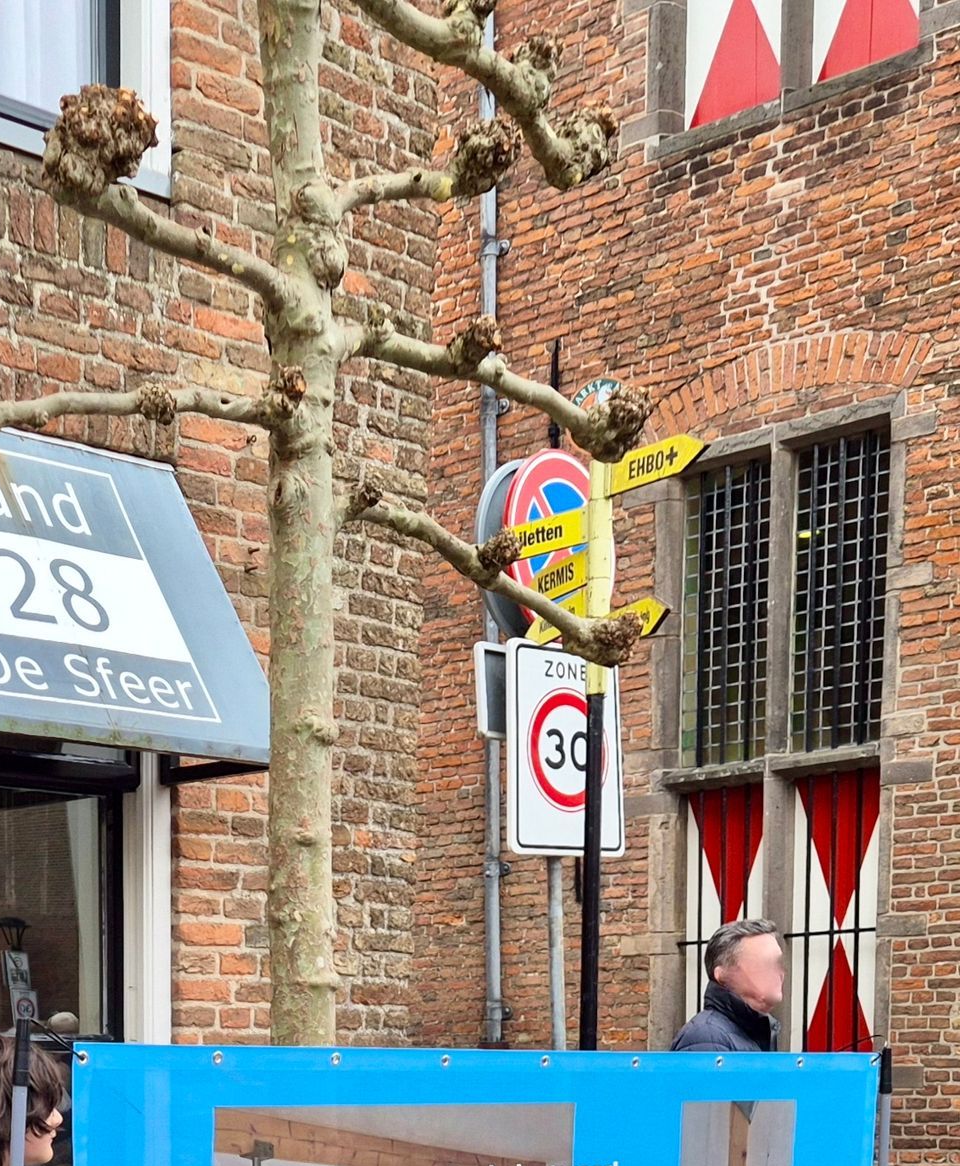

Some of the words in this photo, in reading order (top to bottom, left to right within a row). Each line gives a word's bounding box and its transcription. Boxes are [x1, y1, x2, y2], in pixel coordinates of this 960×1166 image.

[519, 524, 563, 547] iletten
[537, 562, 574, 594] KERMIS
[63, 653, 193, 710] Sfeer
[544, 660, 587, 681] ZONE
[545, 728, 589, 772] 30
